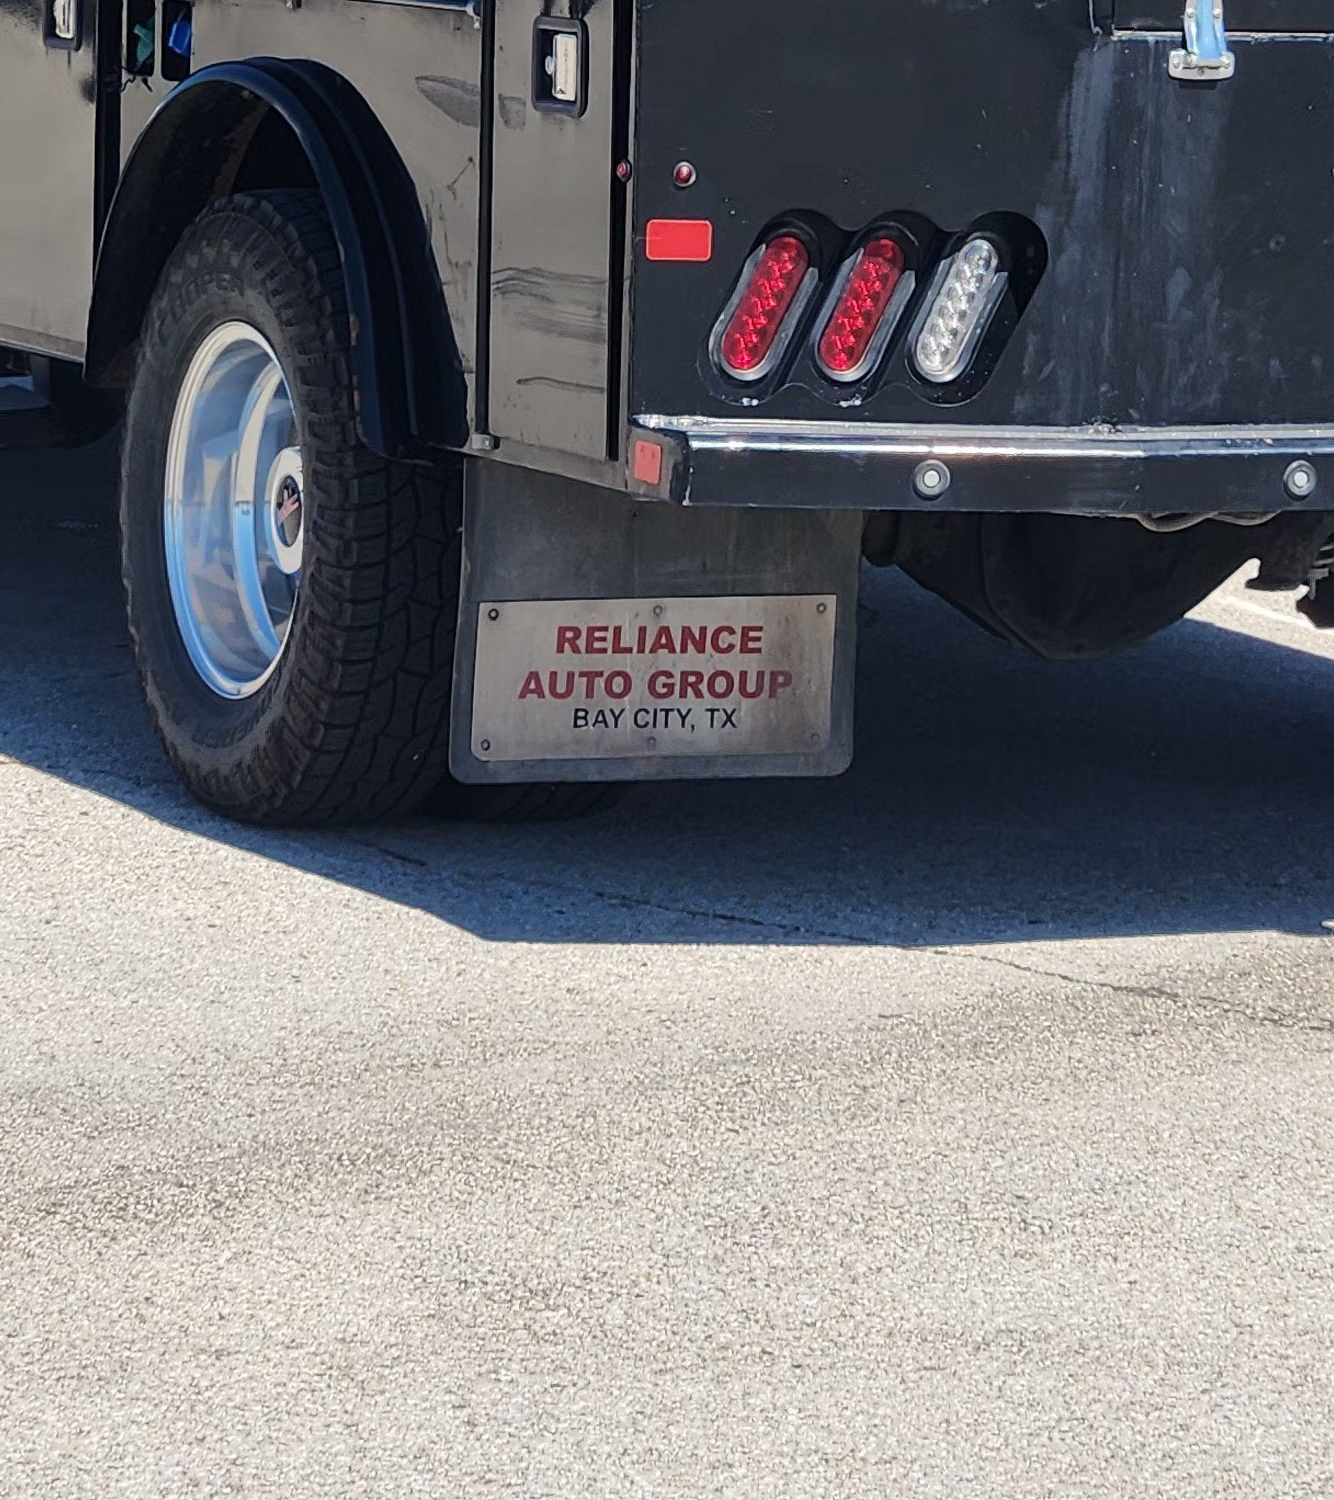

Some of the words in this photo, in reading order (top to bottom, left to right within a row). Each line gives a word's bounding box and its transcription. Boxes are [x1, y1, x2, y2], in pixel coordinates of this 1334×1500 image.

[555, 625, 764, 655] RELIANCE
[518, 670, 633, 700] AUTO
[647, 670, 793, 700] GROUP
[572, 708, 625, 729] BAY
[633, 707, 695, 733] CITY,
[706, 708, 738, 729] TX
